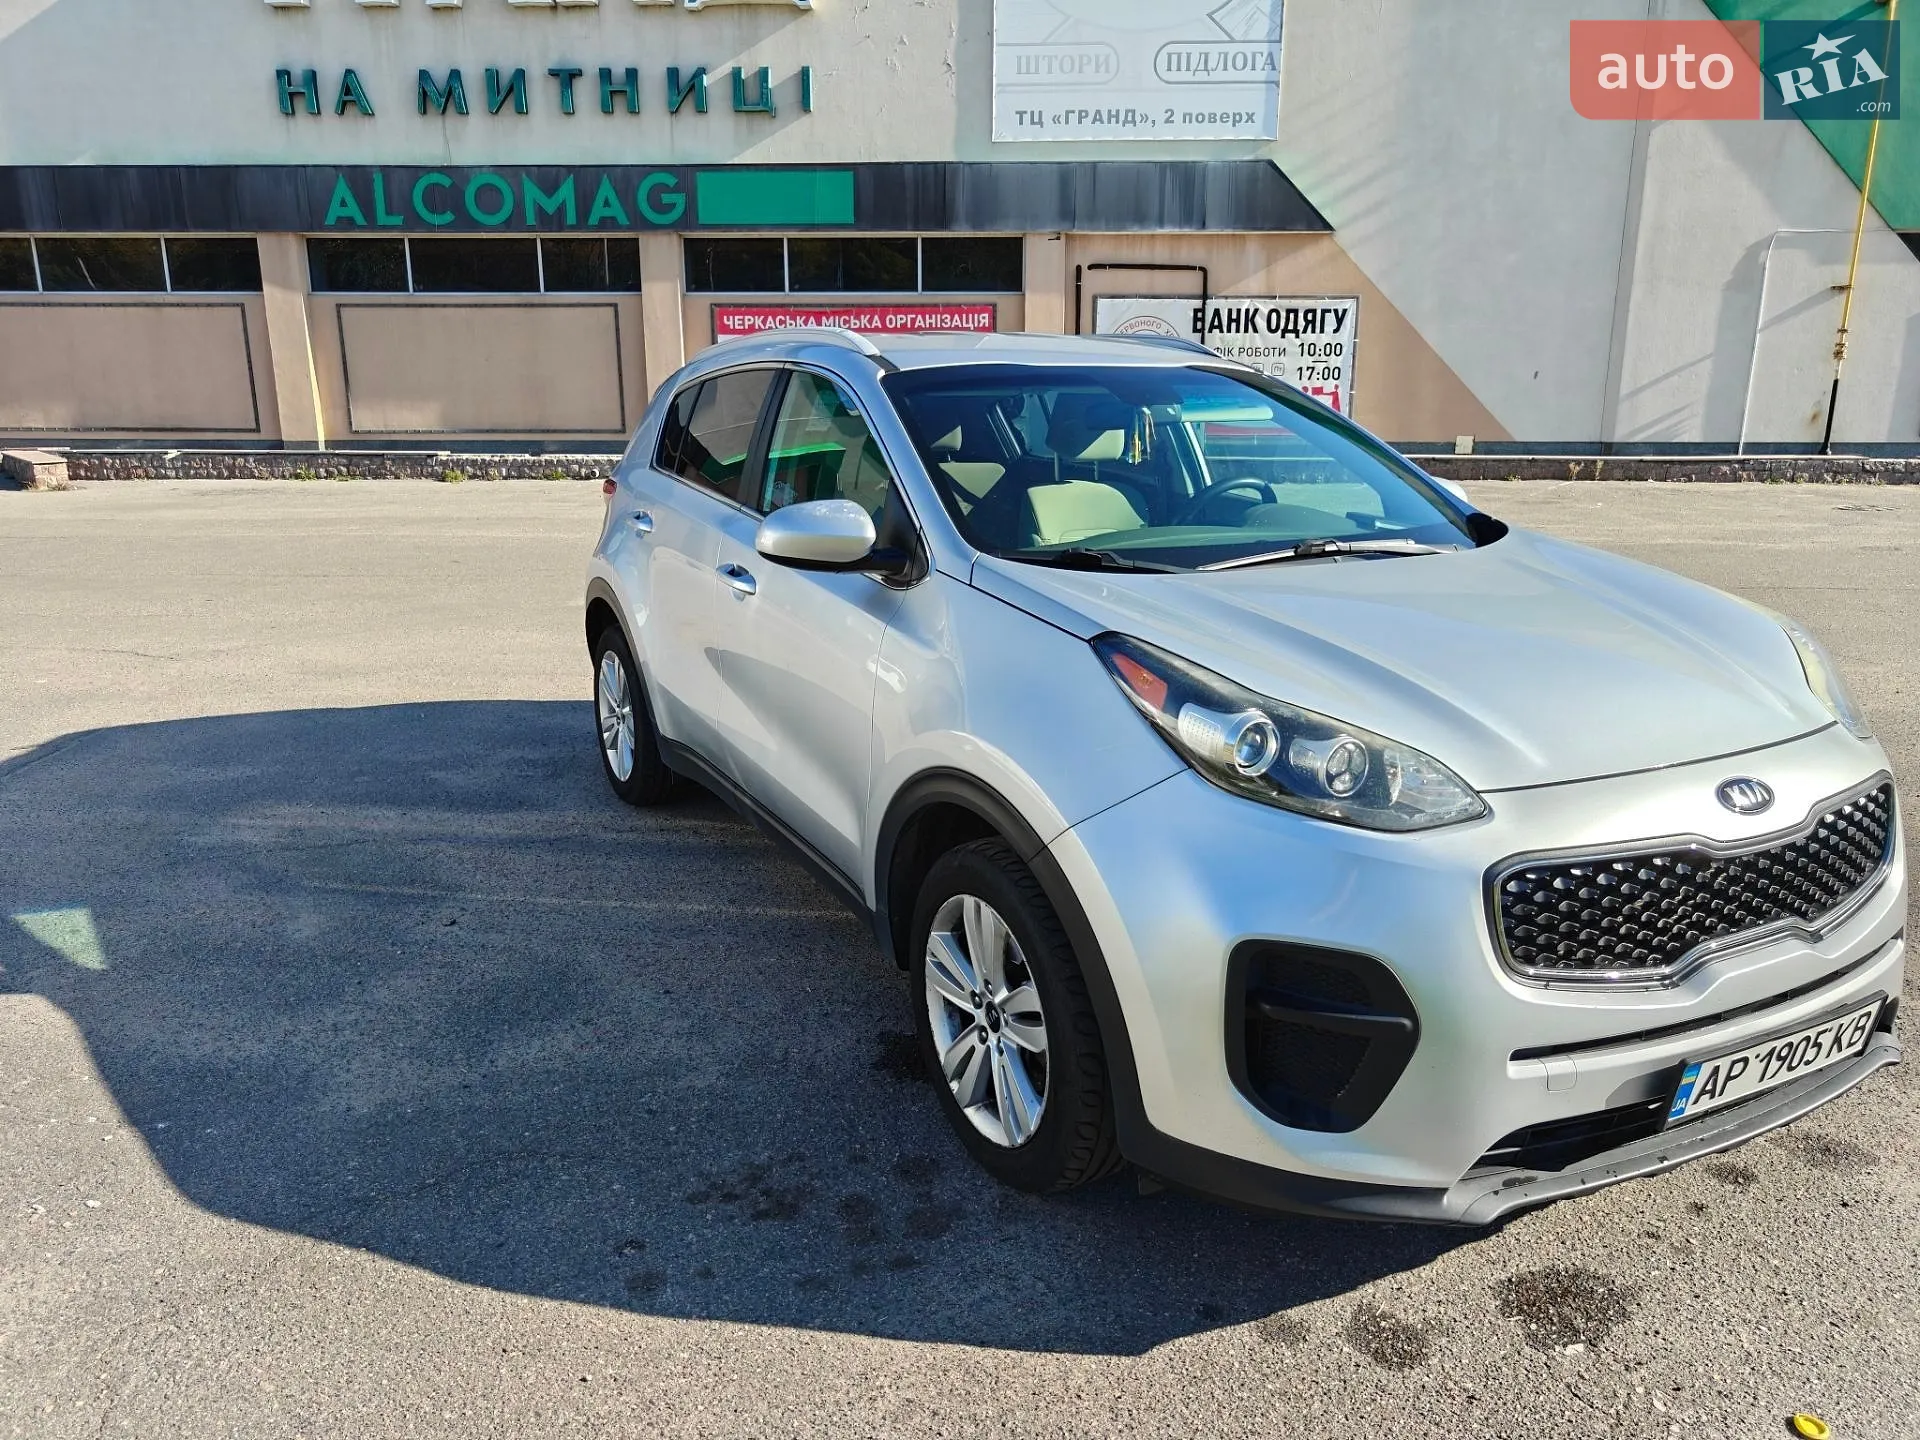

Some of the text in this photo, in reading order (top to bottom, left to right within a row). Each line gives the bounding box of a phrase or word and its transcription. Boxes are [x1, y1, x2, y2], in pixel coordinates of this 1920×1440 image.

[1015, 53, 1111, 75] ШТОРИ
[1165, 50, 1277, 76] ПІДЛОГА
[275, 65, 813, 118] НА МИТНИЦІ
[1015, 108, 1256, 128] ТЦ «ГРАНД», 2 поверх
[325, 171, 686, 227] ALCOMAG
[723, 313, 989, 330] ЧЕРКАСЬКА МІСЬКА ОРГАНІЗАЦІЯ
[1266, 308, 1348, 339] ОДЯГУ
[1238, 347, 1286, 358] РОБОТИ
[1298, 342, 1343, 357] 10:00
[1297, 366, 1341, 381] 17:00
[1758, 1027, 1829, 1084] 1905
